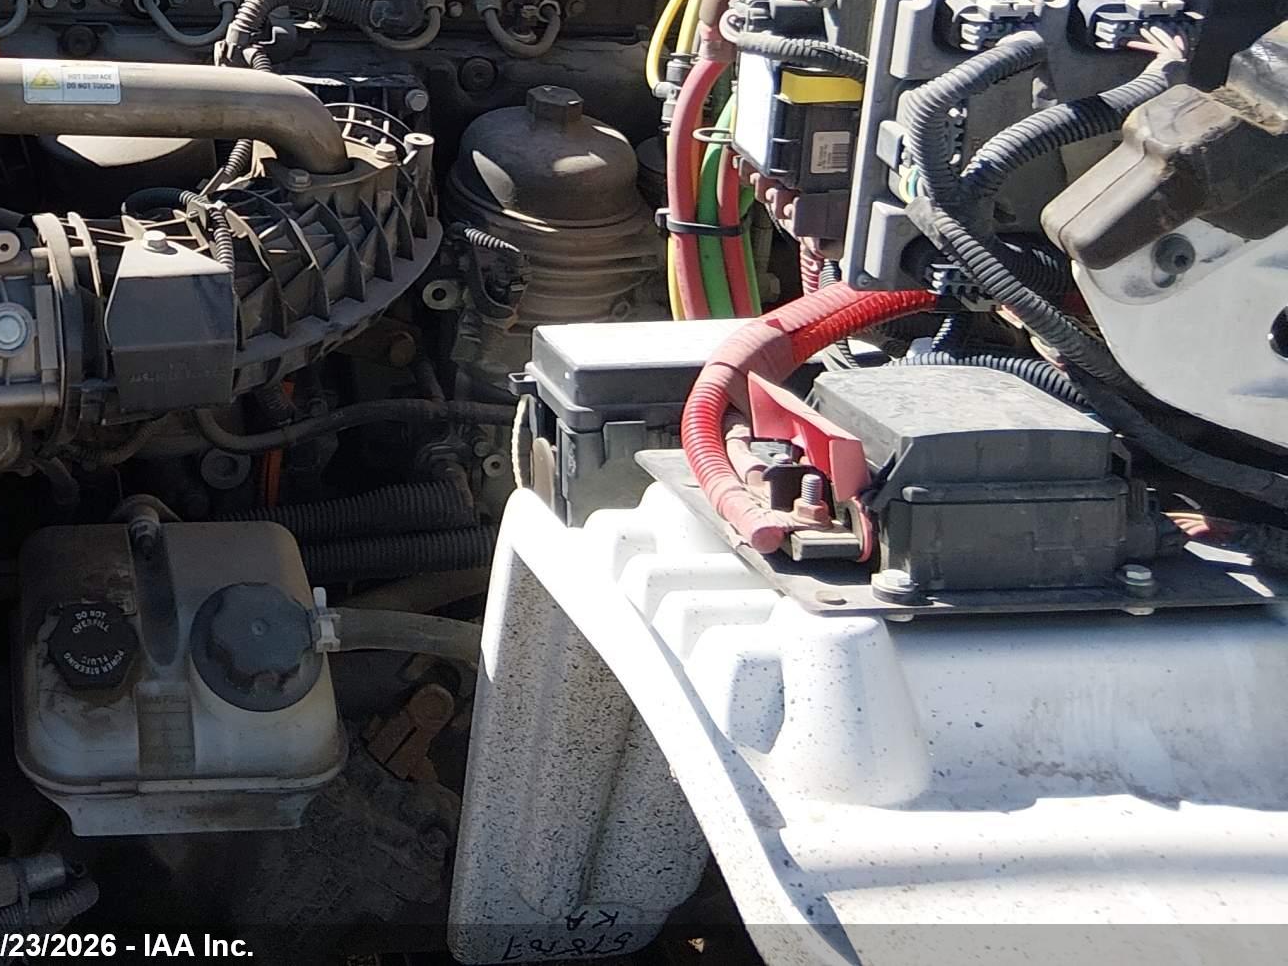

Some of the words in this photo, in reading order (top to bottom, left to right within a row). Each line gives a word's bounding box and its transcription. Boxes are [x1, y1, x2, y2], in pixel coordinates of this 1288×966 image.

[83, 73, 113, 81] SURFACE
[66, 82, 77, 90] DO
[78, 82, 91, 90] NOT
[93, 82, 115, 90] TOUCH
[75, 610, 88, 620] DO
[89, 610, 107, 619] NOT
[71, 618, 111, 634] OVERFILL
[63, 652, 100, 675] STEERING
[101, 649, 125, 673] POWER
